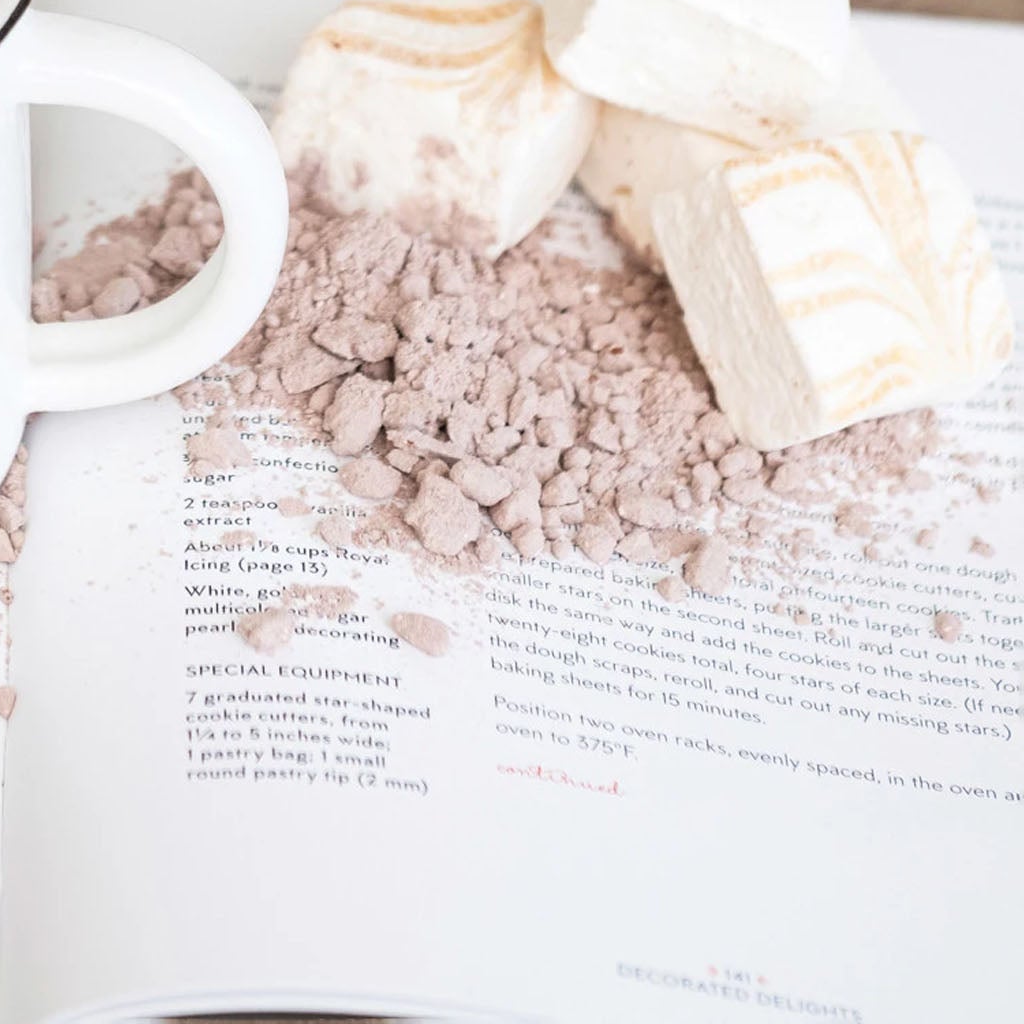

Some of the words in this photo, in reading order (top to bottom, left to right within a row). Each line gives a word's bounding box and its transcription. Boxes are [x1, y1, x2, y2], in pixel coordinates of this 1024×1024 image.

[186, 663, 272, 678] SPECIAL
[278, 665, 401, 689] EQUIPMENT
[488, 611, 608, 647] twenty-eight
[612, 639, 687, 664] cookies
[691, 654, 739, 676] total,
[744, 663, 784, 682] four
[791, 673, 835, 692] stars
[840, 680, 862, 696] of
[865, 687, 913, 703] each
[917, 692, 958, 710] size.
[963, 696, 985, 715] (If
[490, 633, 520, 649] the
[525, 641, 587, 667] dough
[592, 657, 658, 682] scraps,
[663, 671, 719, 695] reroll,
[724, 685, 760, 701] and
[764, 692, 794, 707] cut
[799, 699, 833, 713] out
[837, 703, 871, 724] any
[876, 709, 950, 736] missing
[954, 722, 1012, 742] stars.)
[490, 655, 556, 686] baking
[560, 671, 622, 696] sheets
[627, 683, 656, 702] for
[661, 691, 681, 708] 15
[686, 699, 766, 725] minutes.
[186, 690, 198, 705] 7
[203, 688, 307, 708] graduated
[313, 695, 431, 720] star-shaped
[185, 707, 252, 724] cookie
[341, 713, 389, 732] from
[495, 722, 544, 742] oven
[549, 731, 571, 746] to
[222, 728, 243, 741] to
[249, 725, 261, 741] 5
[267, 726, 331, 745] inches
[494, 694, 572, 723] Position
[579, 715, 615, 732] two
[620, 725, 669, 744] oven
[674, 735, 732, 759] racks,
[737, 748, 801, 773] evenly
[806, 759, 882, 785] spaced,
[887, 770, 905, 787] in
[911, 775, 944, 793] the
[948, 783, 998, 800] oven
[187, 747, 193, 761] 1
[200, 747, 265, 765] pastry
[320, 748, 328, 763] 1
[334, 752, 386, 769] small
[186, 765, 247, 781] round
[252, 766, 318, 785] pastry
[322, 768, 350, 787] tip
[617, 962, 750, 1002] DECORATED
[756, 991, 863, 1023] DELIGHTS
